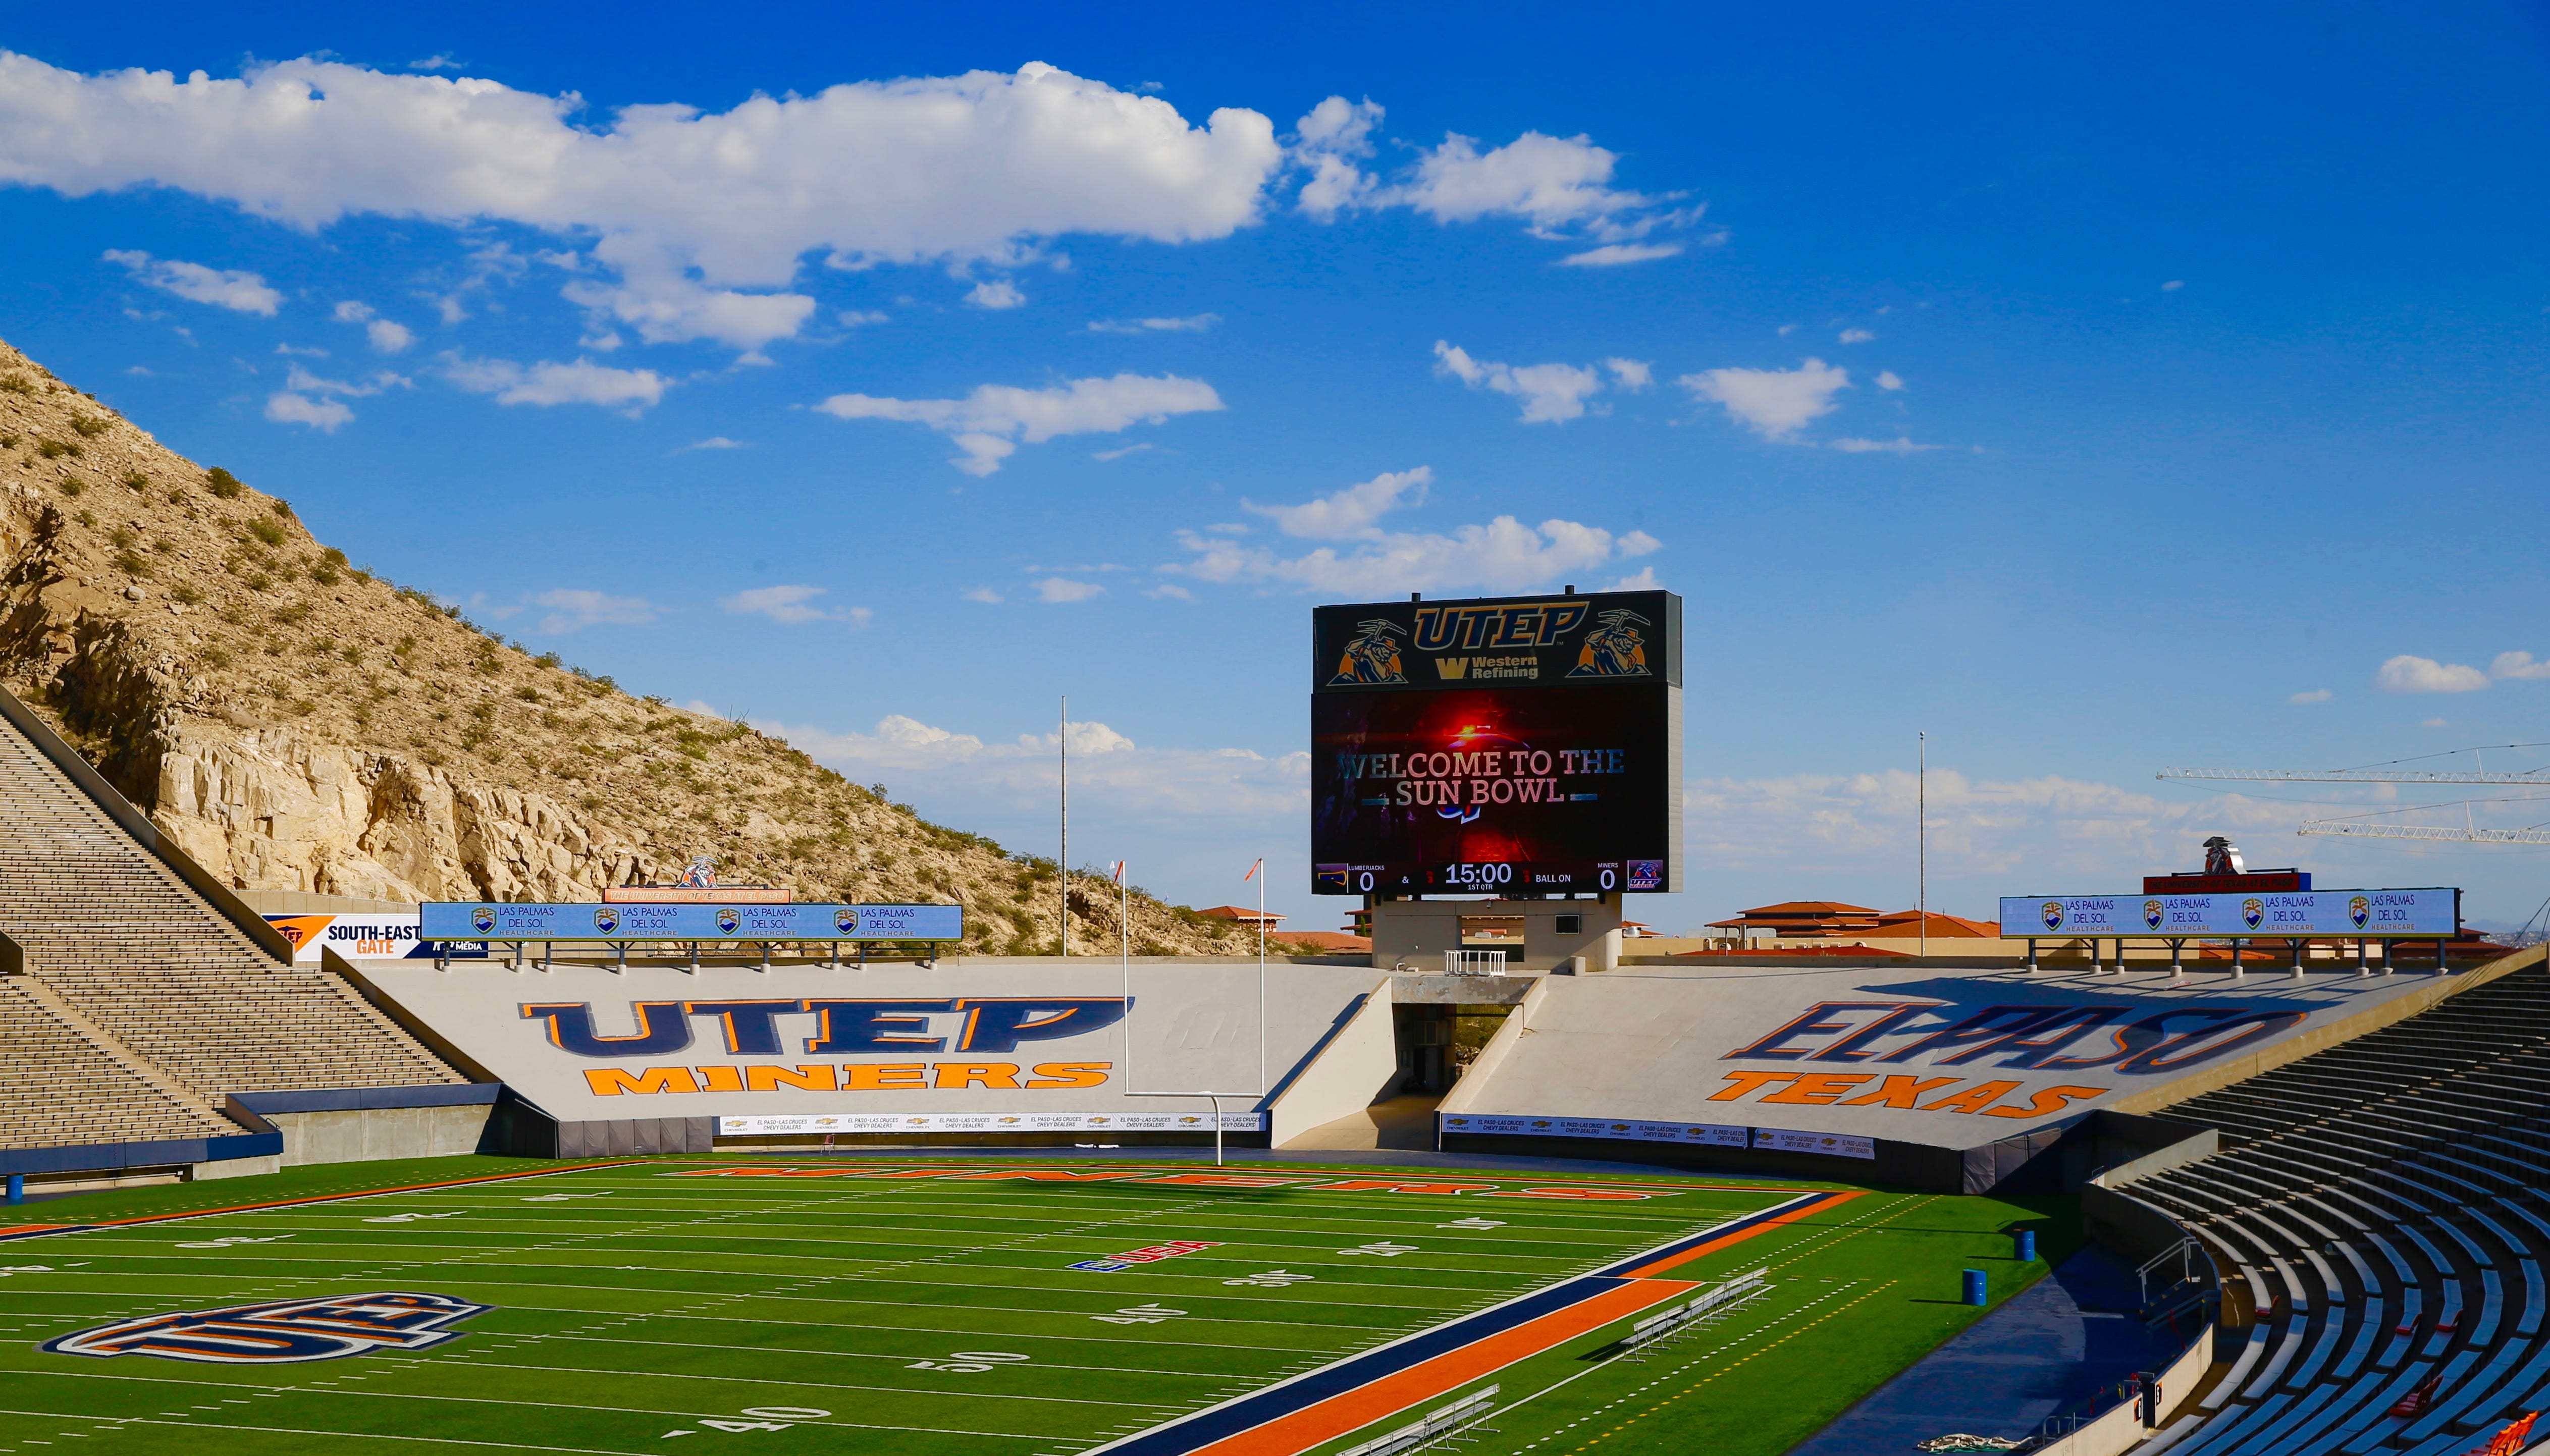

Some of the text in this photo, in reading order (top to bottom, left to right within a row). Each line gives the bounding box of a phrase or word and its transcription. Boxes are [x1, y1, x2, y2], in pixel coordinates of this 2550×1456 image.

[1414, 602, 1590, 651] UTEP
[1472, 656, 1537, 667] Western
[1472, 667, 1538, 679] Refining
[1339, 749, 1624, 779] WELCOME TO THE
[1396, 778, 1564, 806] SUN BOWL
[1446, 864, 1512, 883] 15:00
[1524, 875, 1530, 883] 3
[1600, 870, 1615, 889] 0
[1360, 872, 1374, 891] 0
[2149, 881, 2163, 889] THE
[2164, 880, 2208, 889] UNIVERSITY
[2210, 880, 2221, 888] OF
[2223, 879, 2247, 888] TEXAS
[2249, 879, 2259, 887] AT
[2260, 878, 2269, 887] EL
[610, 891, 784, 900] THE UNIVERSITY OF TEXAS AT EL PASO
[2266, 896, 2314, 907] LAS PALMAS
[2371, 895, 2415, 906] LAS PALMAS
[2066, 900, 2114, 911] LAS PALMAS
[2165, 898, 2210, 909] LAS PALMAS
[500, 906, 554, 916] LAS PALMAS
[622, 907, 677, 916] LAS PALMAS
[743, 908, 796, 917] LAS PALMAS
[861, 908, 915, 918] LAS PALMAS
[2274, 911, 2306, 922] DEL SOL
[2378, 909, 2408, 920] DEL SOL
[509, 919, 545, 928] DEL SOL
[631, 919, 668, 928] DEL SOL
[2074, 913, 2107, 924] DEL SOL
[2173, 912, 2203, 923] DEL SOL
[752, 920, 787, 929] DEL SOL
[870, 920, 906, 929] DEL SOL
[329, 926, 420, 940] SOUTH-EAST
[357, 939, 394, 954] GATE
[518, 997, 1136, 1059] UTEP
[1717, 1001, 2311, 1075] EL PASO
[582, 1062, 1113, 1097] MINERS
[1705, 1070, 2113, 1119] TEXAS
[651, 1167, 1687, 1201] MINERS
[1436, 1219, 1508, 1231] 10
[175, 1236, 276, 1248] 30
[1336, 1244, 1419, 1257] 20
[1222, 1273, 1315, 1287] 30
[1089, 1308, 1189, 1325] 40
[35, 1291, 500, 1365] UTEP
[904, 1351, 1030, 1373] 50
[698, 1406, 832, 1433] 40
